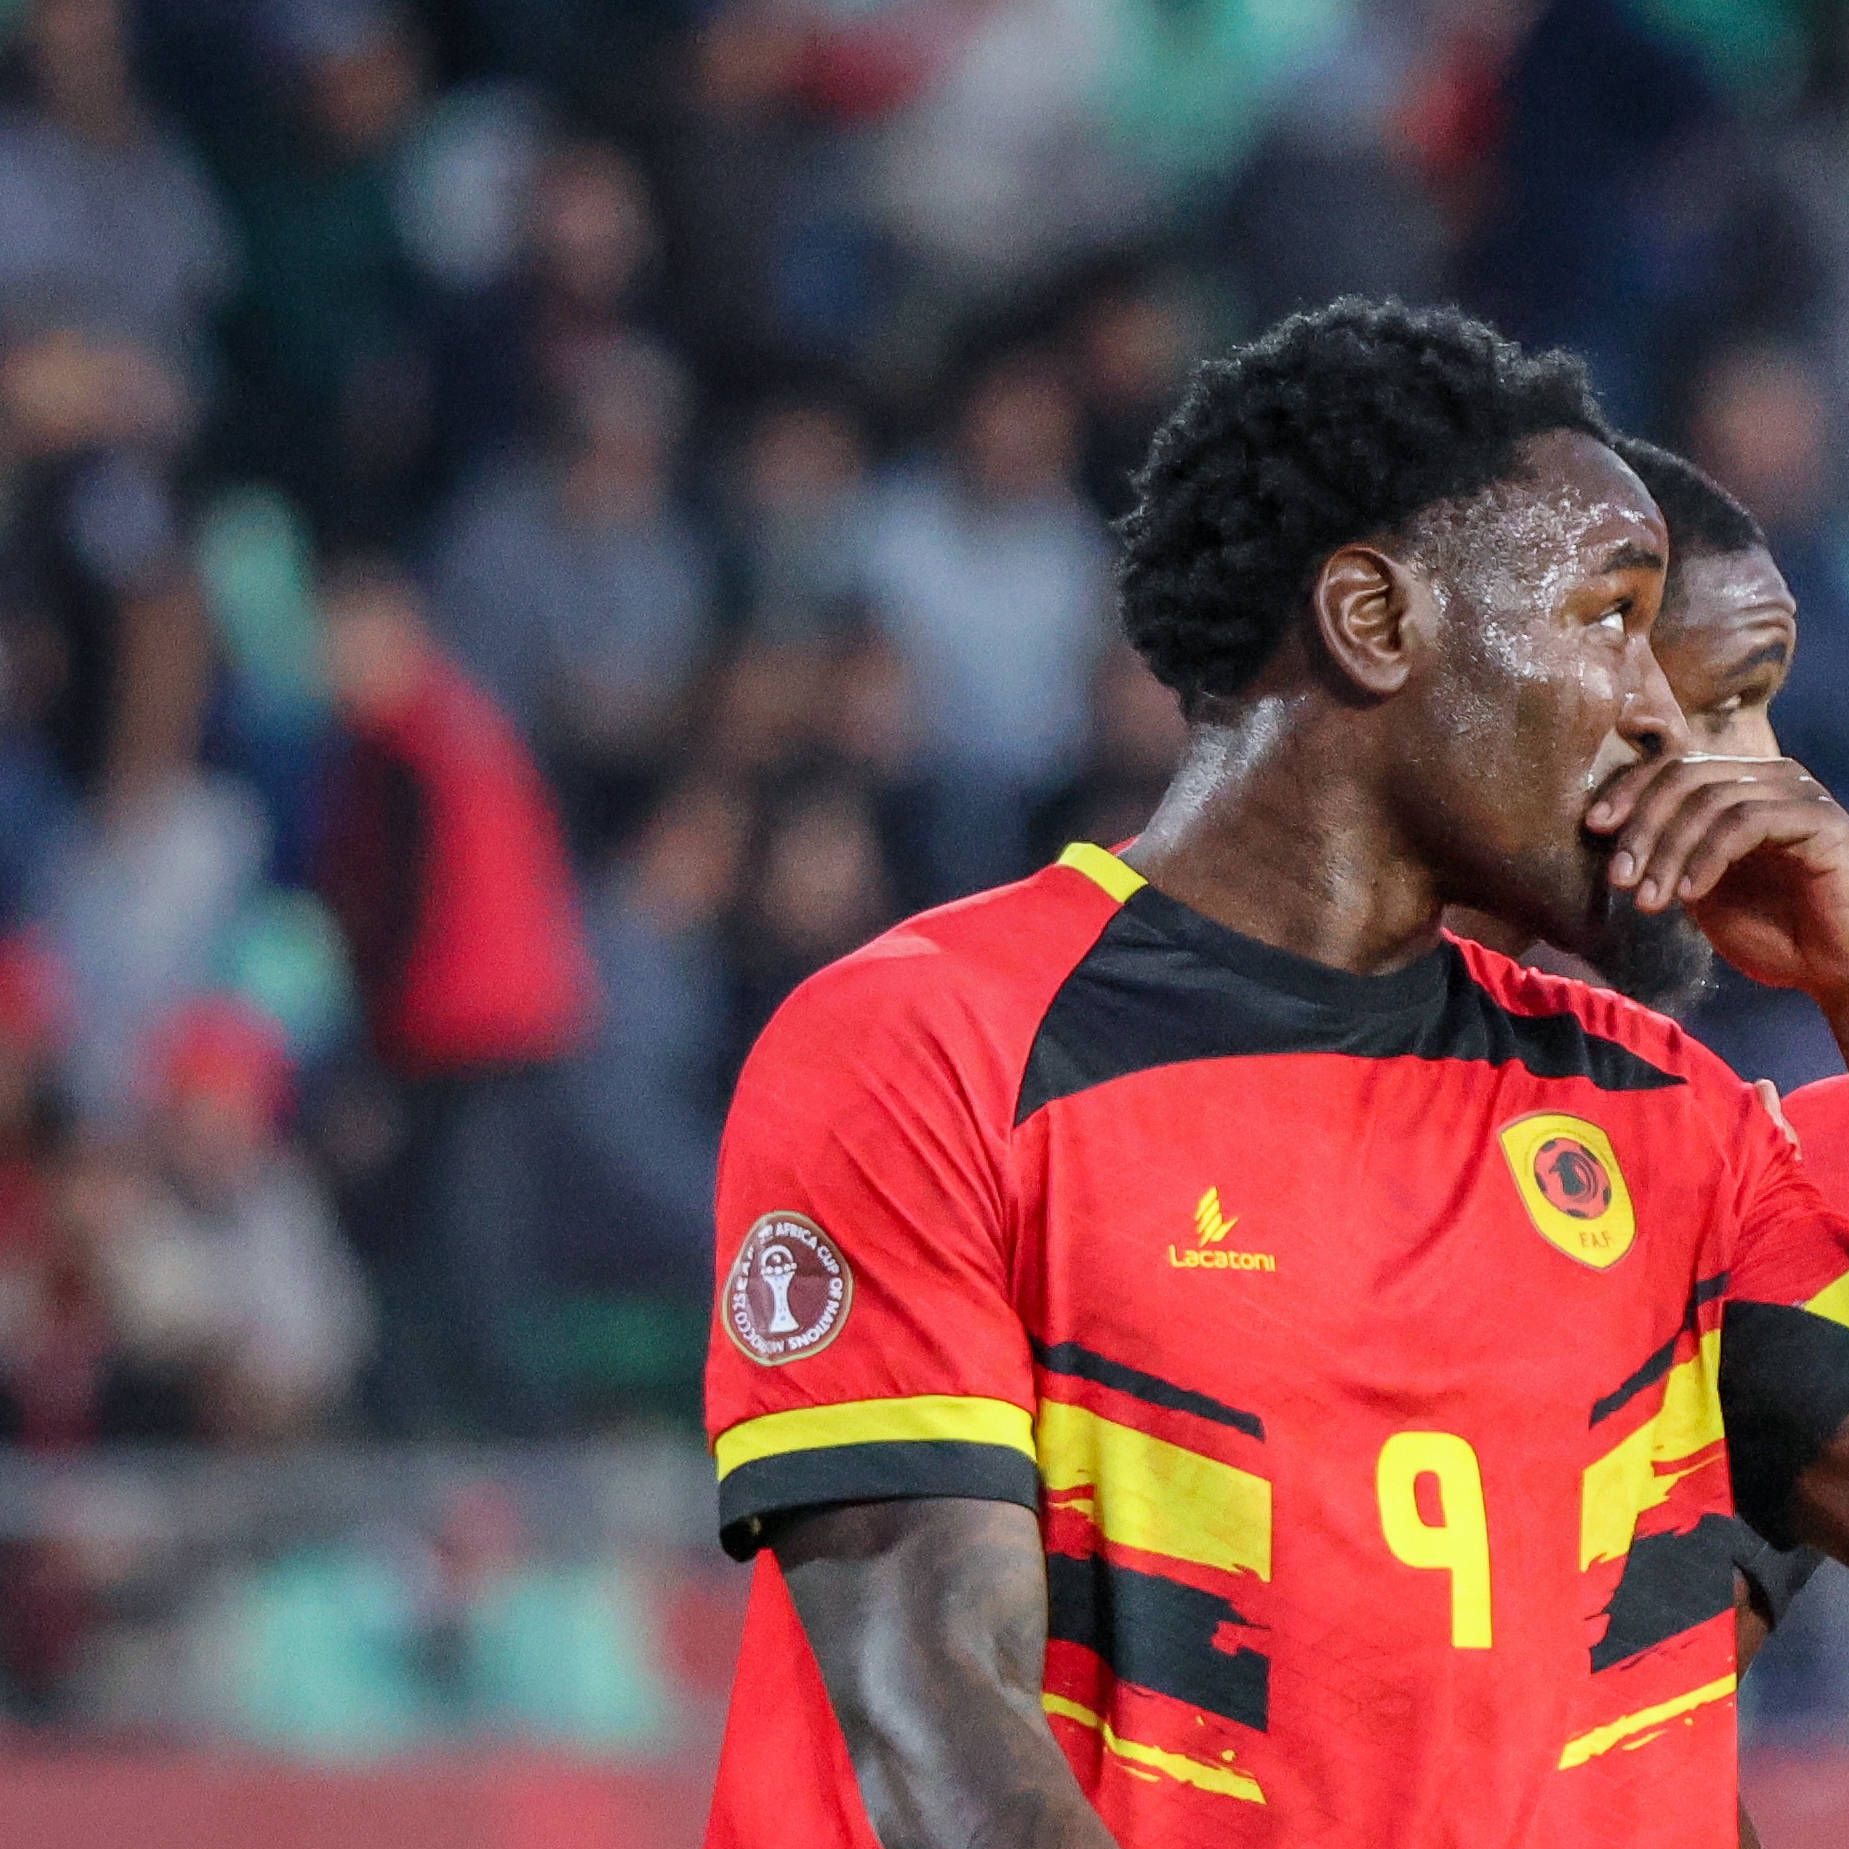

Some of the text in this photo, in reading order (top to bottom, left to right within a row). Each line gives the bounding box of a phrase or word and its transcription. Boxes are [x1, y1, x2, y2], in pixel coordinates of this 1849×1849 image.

[776, 1222, 843, 1349] AFRICA CUP OF NATIONS
[1168, 1244, 1276, 1272] Lacatoni
[1376, 1431, 1493, 1648] 9
